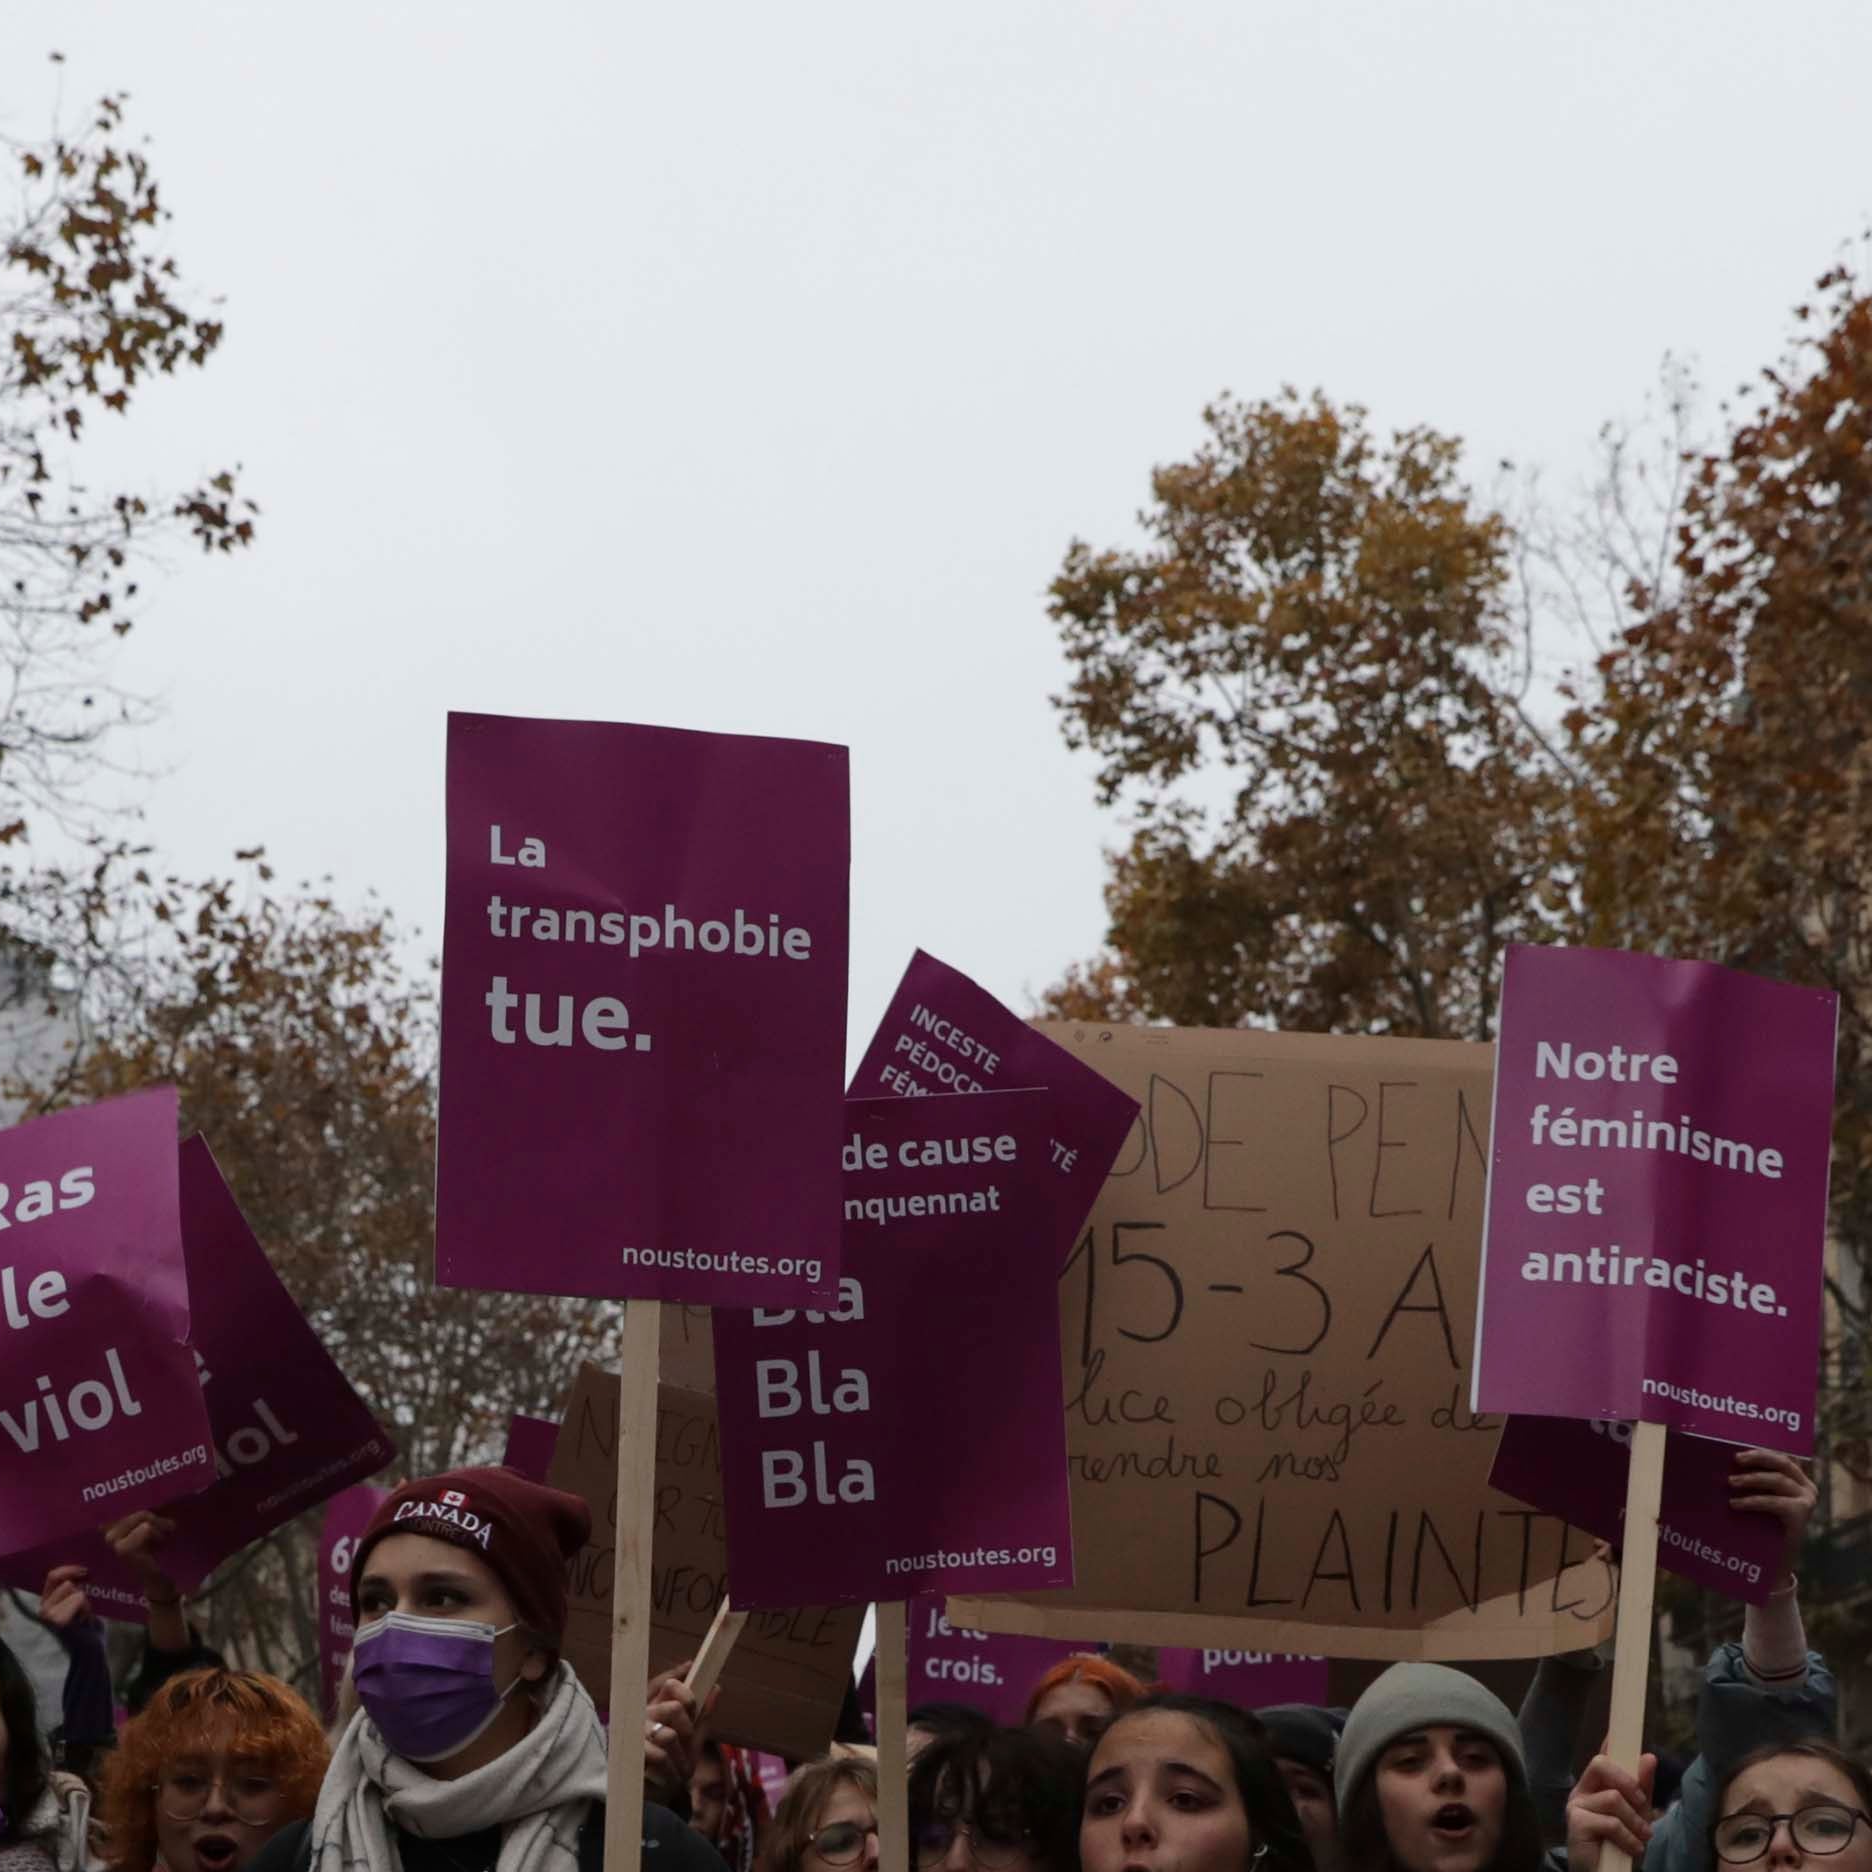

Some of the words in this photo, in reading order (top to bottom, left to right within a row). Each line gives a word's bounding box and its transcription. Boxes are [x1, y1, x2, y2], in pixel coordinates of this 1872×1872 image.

[489, 825, 546, 868] La
[488, 896, 811, 960] transphobie
[485, 976, 652, 1052] tue.
[909, 1004, 1000, 1075] INCESTE
[1535, 1041, 1678, 1084] Notre
[898, 1133, 1016, 1168] cause
[1329, 1081, 1488, 1221] PEN
[1531, 1104, 1783, 1179] féminisme
[844, 1185, 1000, 1226] nquennat
[1526, 1177, 1604, 1215] est
[622, 1244, 822, 1283] noustoutes.org
[1521, 1245, 1787, 1317] antiraciste.
[1, 1266, 71, 1329] le
[756, 1350, 870, 1418] Bla
[1068, 1348, 1167, 1425] lice
[1642, 1378, 1800, 1431] noustoutes.org
[82, 1444, 207, 1502] noustoutes.org
[761, 1440, 875, 1508] Bla
[1072, 1437, 1221, 1482] rendre
[393, 1500, 494, 1550] CANADA
[885, 1546, 1056, 1575] noustoutes.org
[925, 1655, 1005, 1686] crois.
